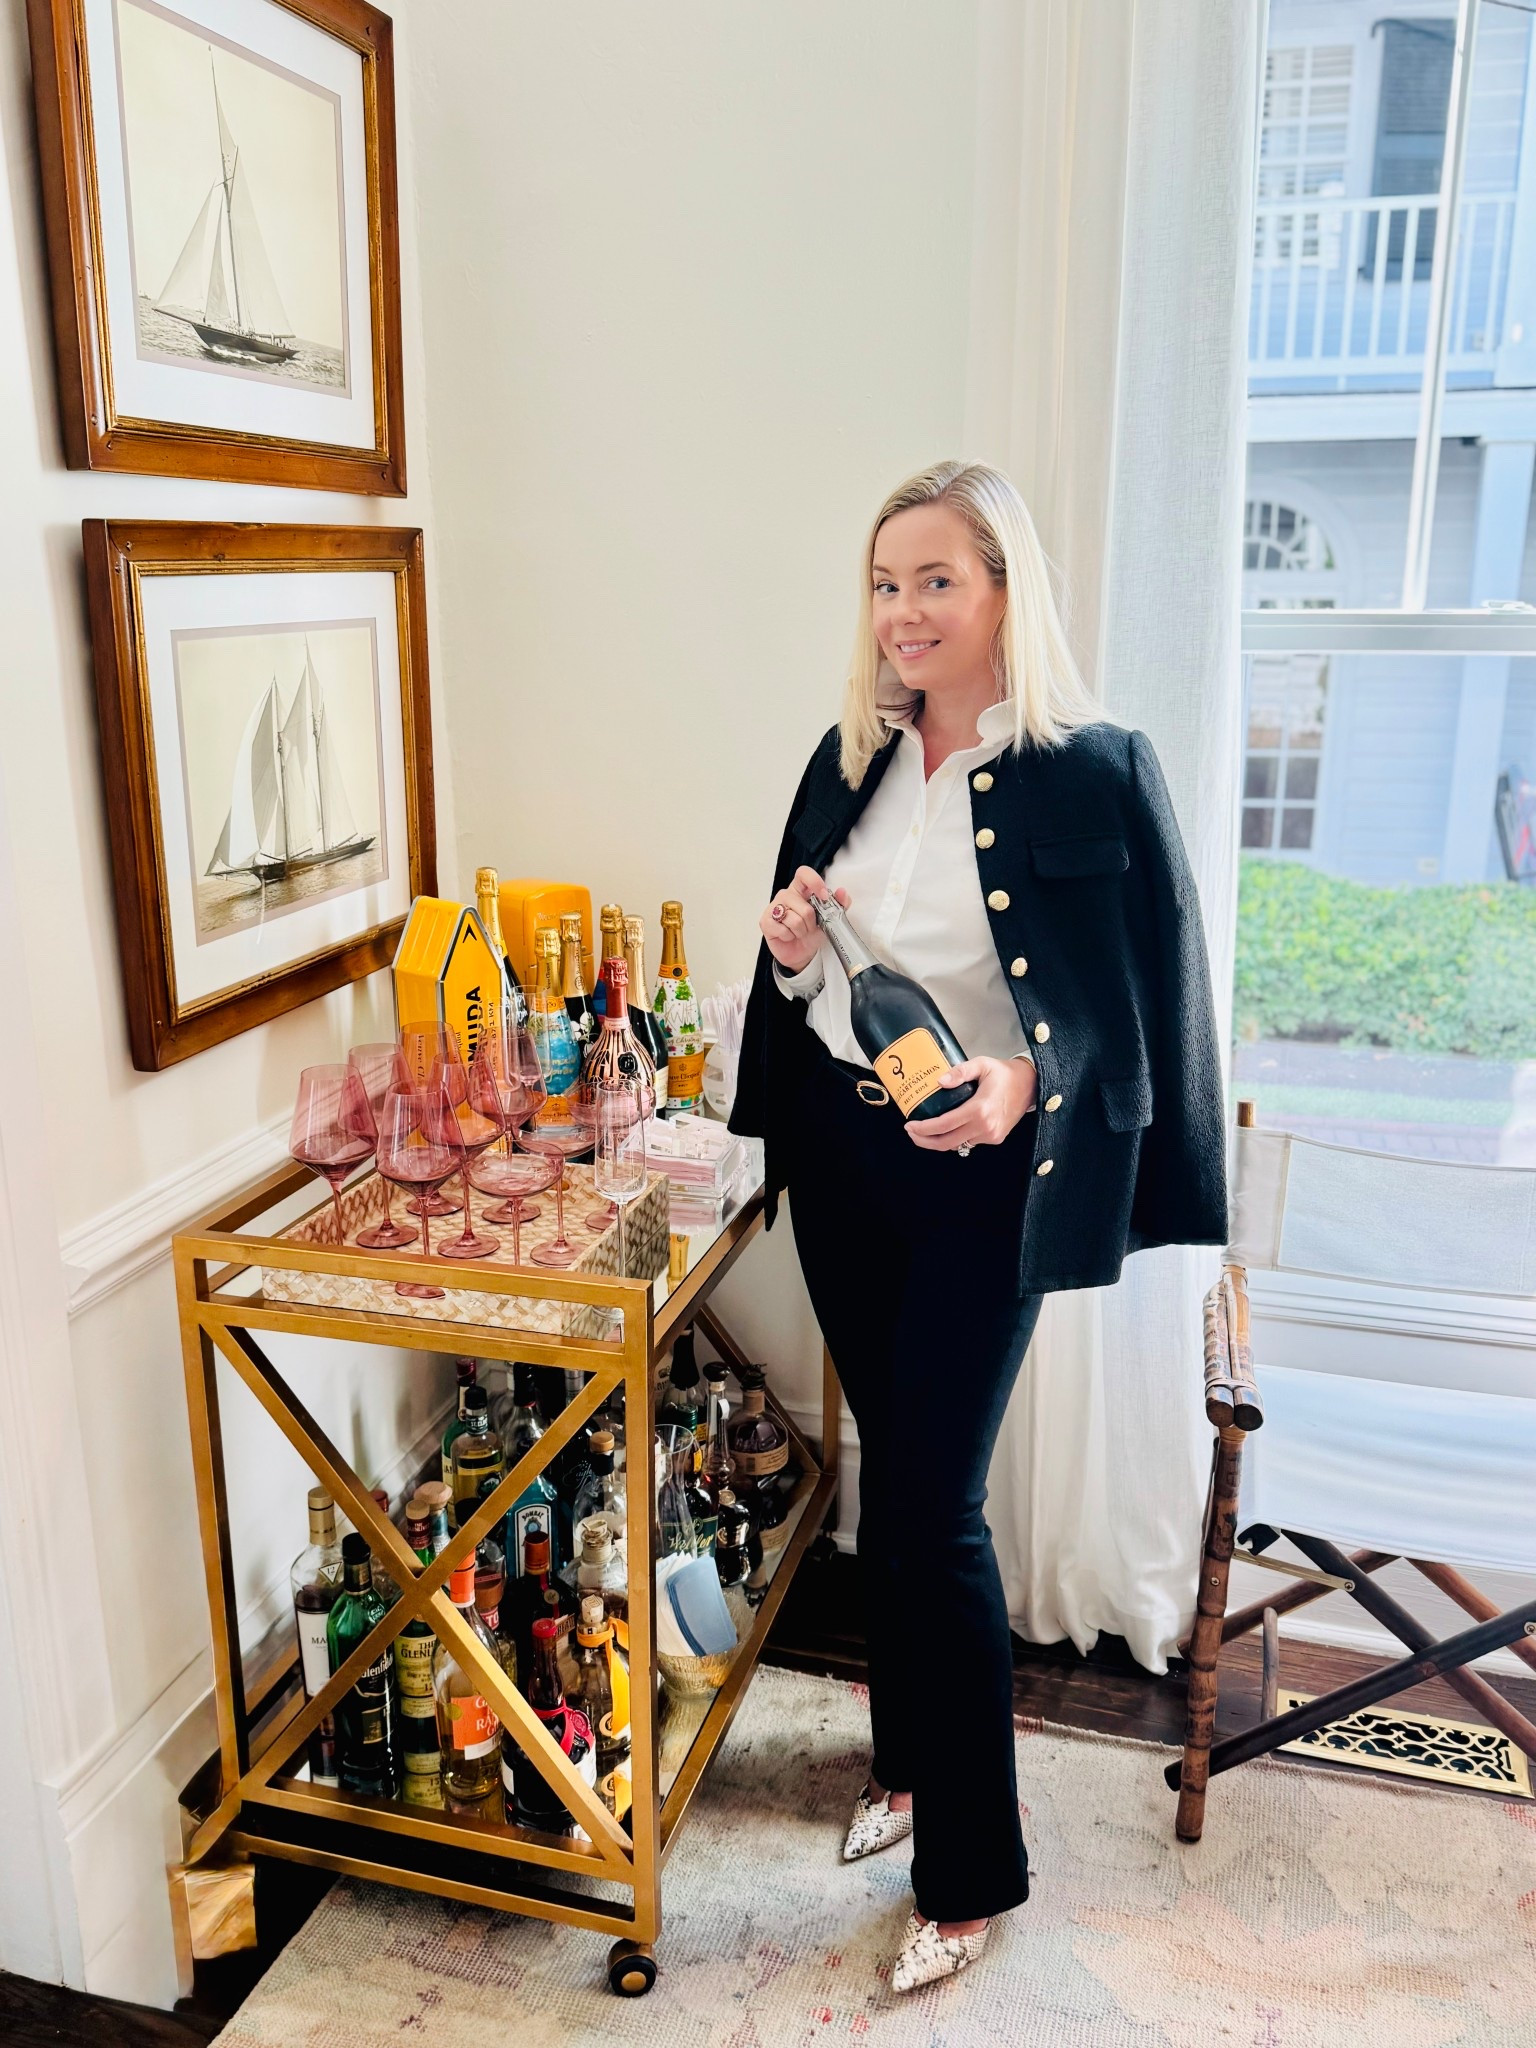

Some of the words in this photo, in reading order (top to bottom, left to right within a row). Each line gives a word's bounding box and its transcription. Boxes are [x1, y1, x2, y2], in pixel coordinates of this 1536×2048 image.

[522, 1510, 544, 1521] BOMBAY
[326, 1566, 335, 1575] 12
[401, 1648, 433, 1659] GLENL
